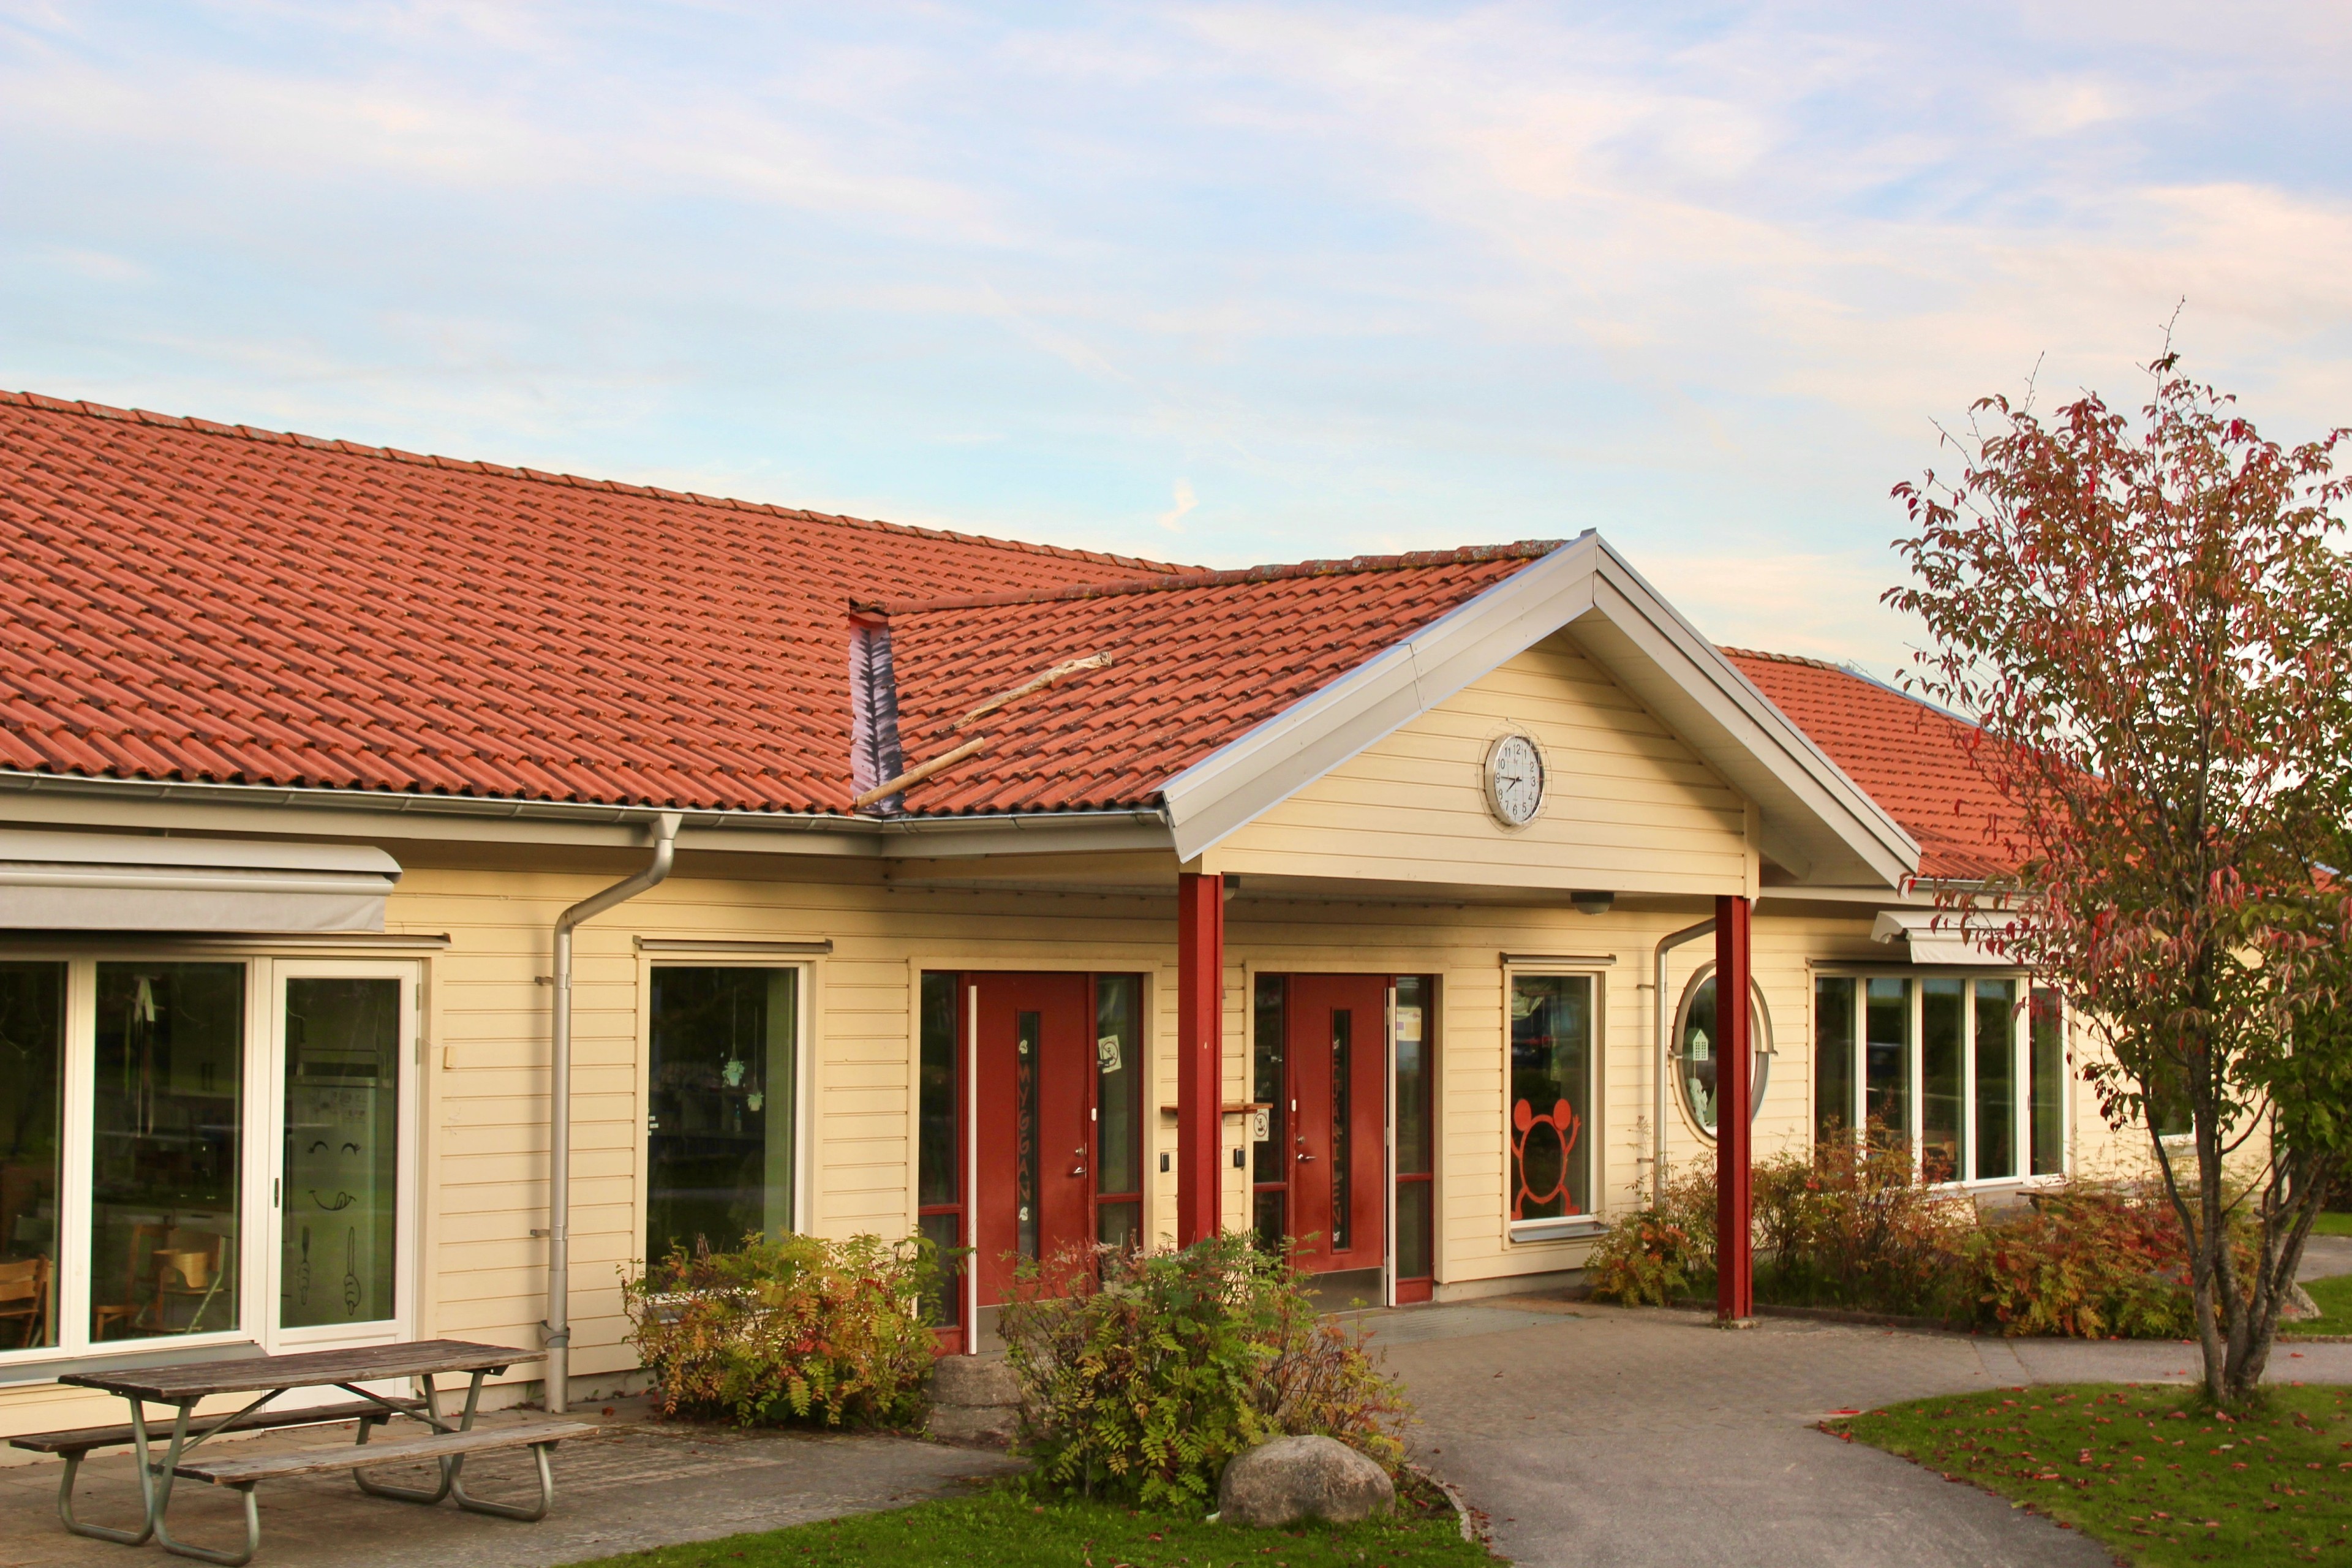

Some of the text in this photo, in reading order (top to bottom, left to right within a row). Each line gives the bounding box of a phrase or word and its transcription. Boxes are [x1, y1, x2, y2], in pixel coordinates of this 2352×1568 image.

[1505, 747, 1510, 757] 11
[1513, 744, 1520, 755] 12
[1524, 749, 1526, 759] 1
[1498, 758, 1505, 769] 10
[1530, 761, 1534, 772] 2
[1496, 772, 1500, 783] 9
[1531, 776, 1536, 787] 3
[1498, 789, 1502, 800] 8
[1505, 801, 1509, 810] 7
[1512, 804, 1517, 815] 6
[1522, 802, 1526, 813] 5
[1019, 1063, 1030, 1201] MYGGAN
